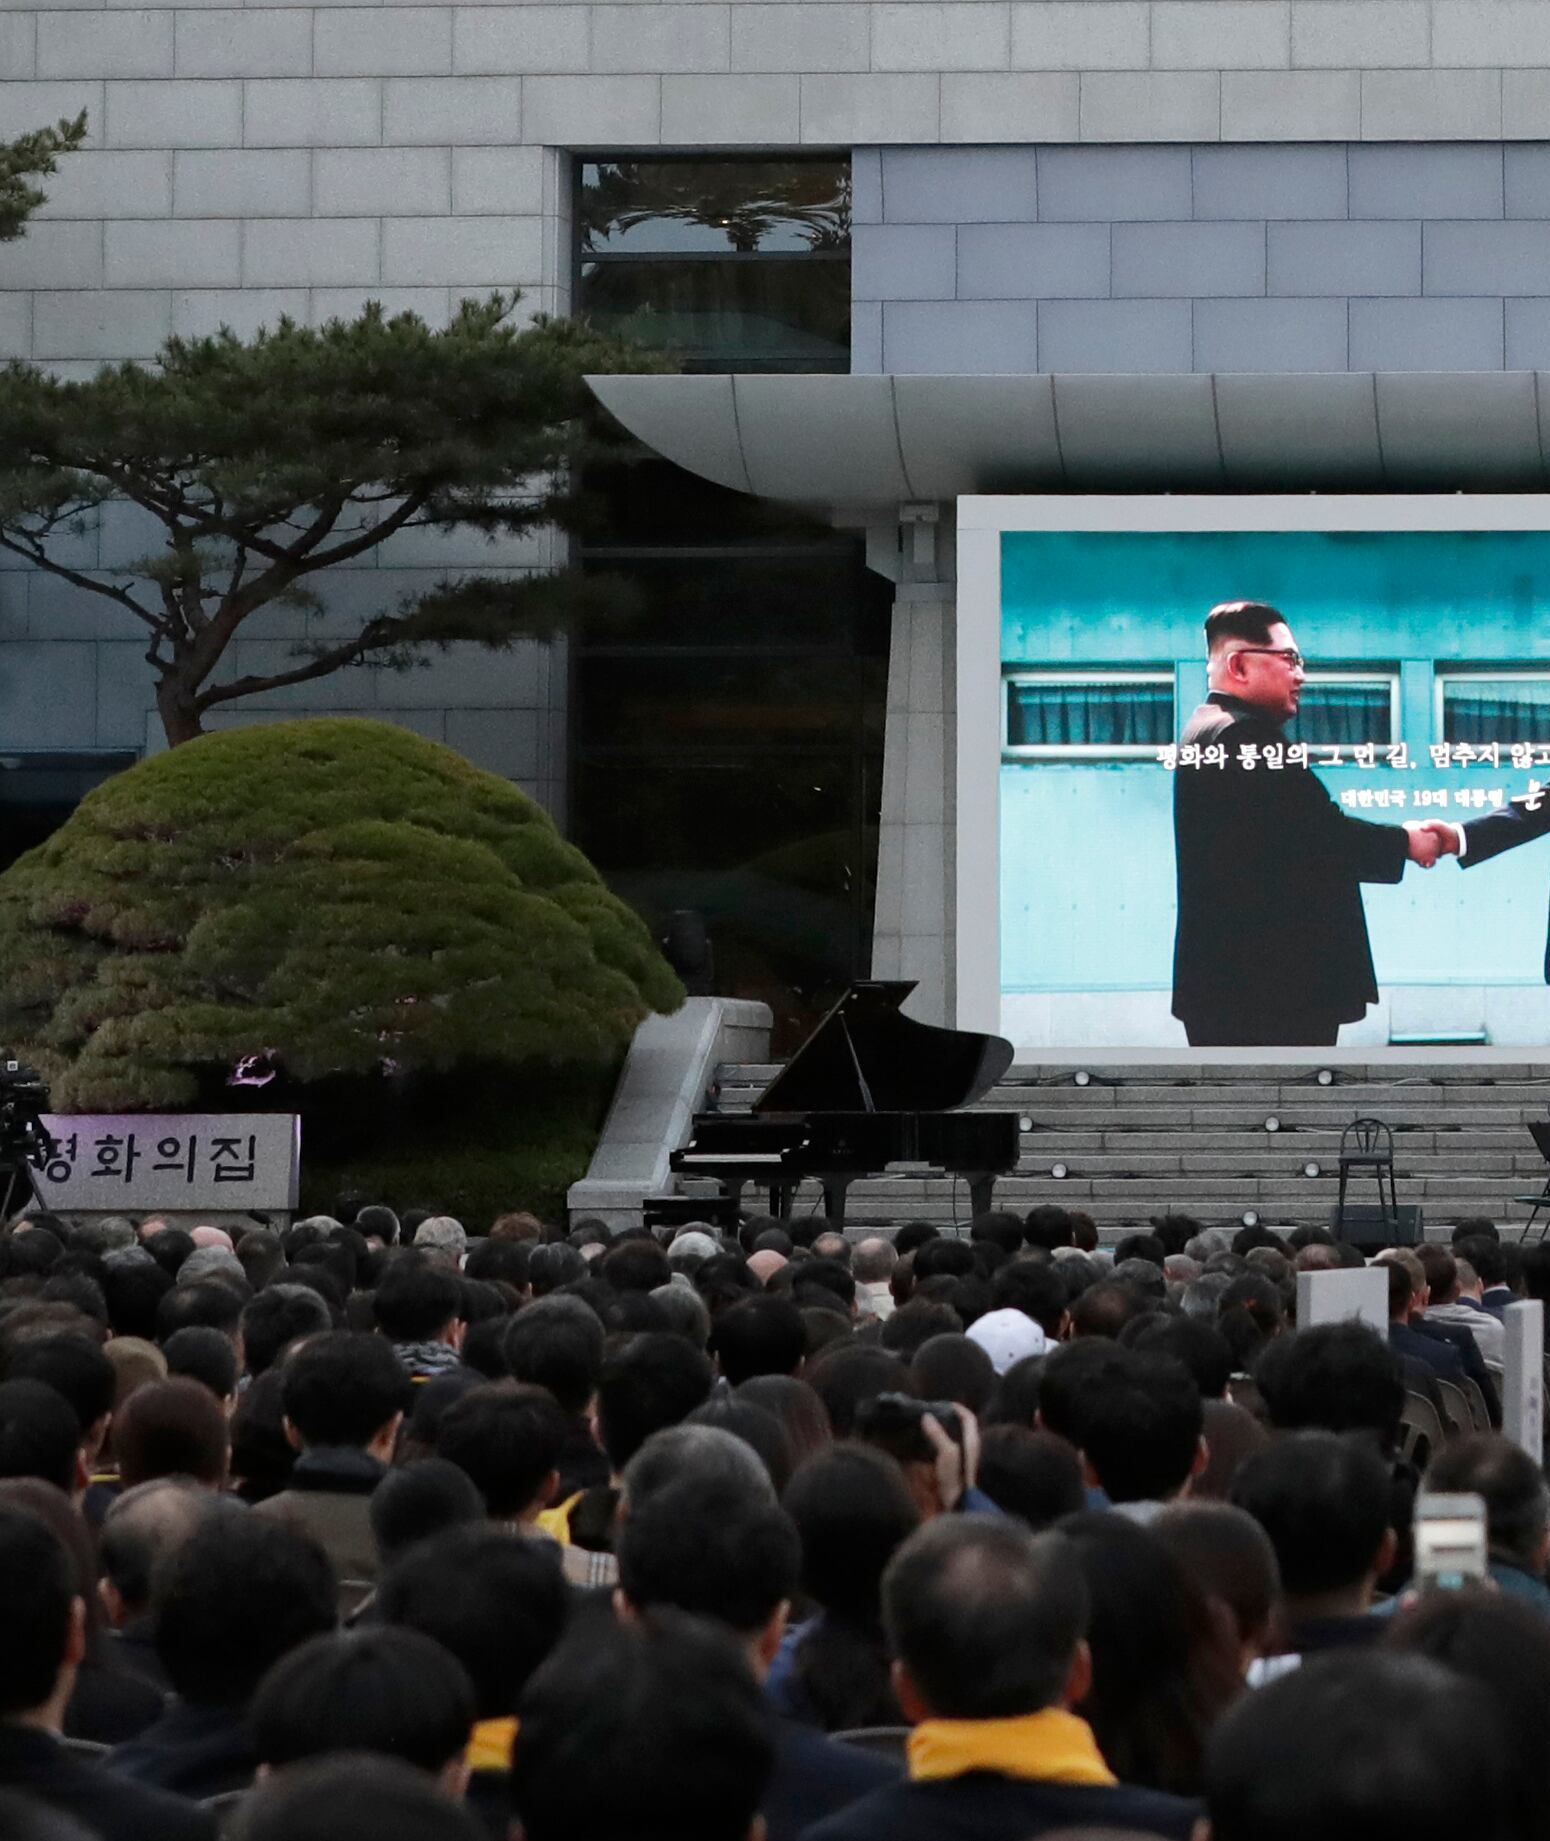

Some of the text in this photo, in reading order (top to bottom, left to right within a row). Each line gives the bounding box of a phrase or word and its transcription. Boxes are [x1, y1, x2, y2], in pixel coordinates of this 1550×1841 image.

[1156, 743, 1229, 770] 평화와
[1237, 743, 1308, 770] 통일의
[1318, 744, 1344, 766] 그
[1354, 743, 1375, 768] 먼
[1386, 743, 1417, 770] 길,
[1430, 742, 1499, 769] 멈추지
[1341, 789, 1406, 807] 대한민국
[1412, 789, 1448, 807] 19대
[1454, 788, 1503, 808] 대통령
